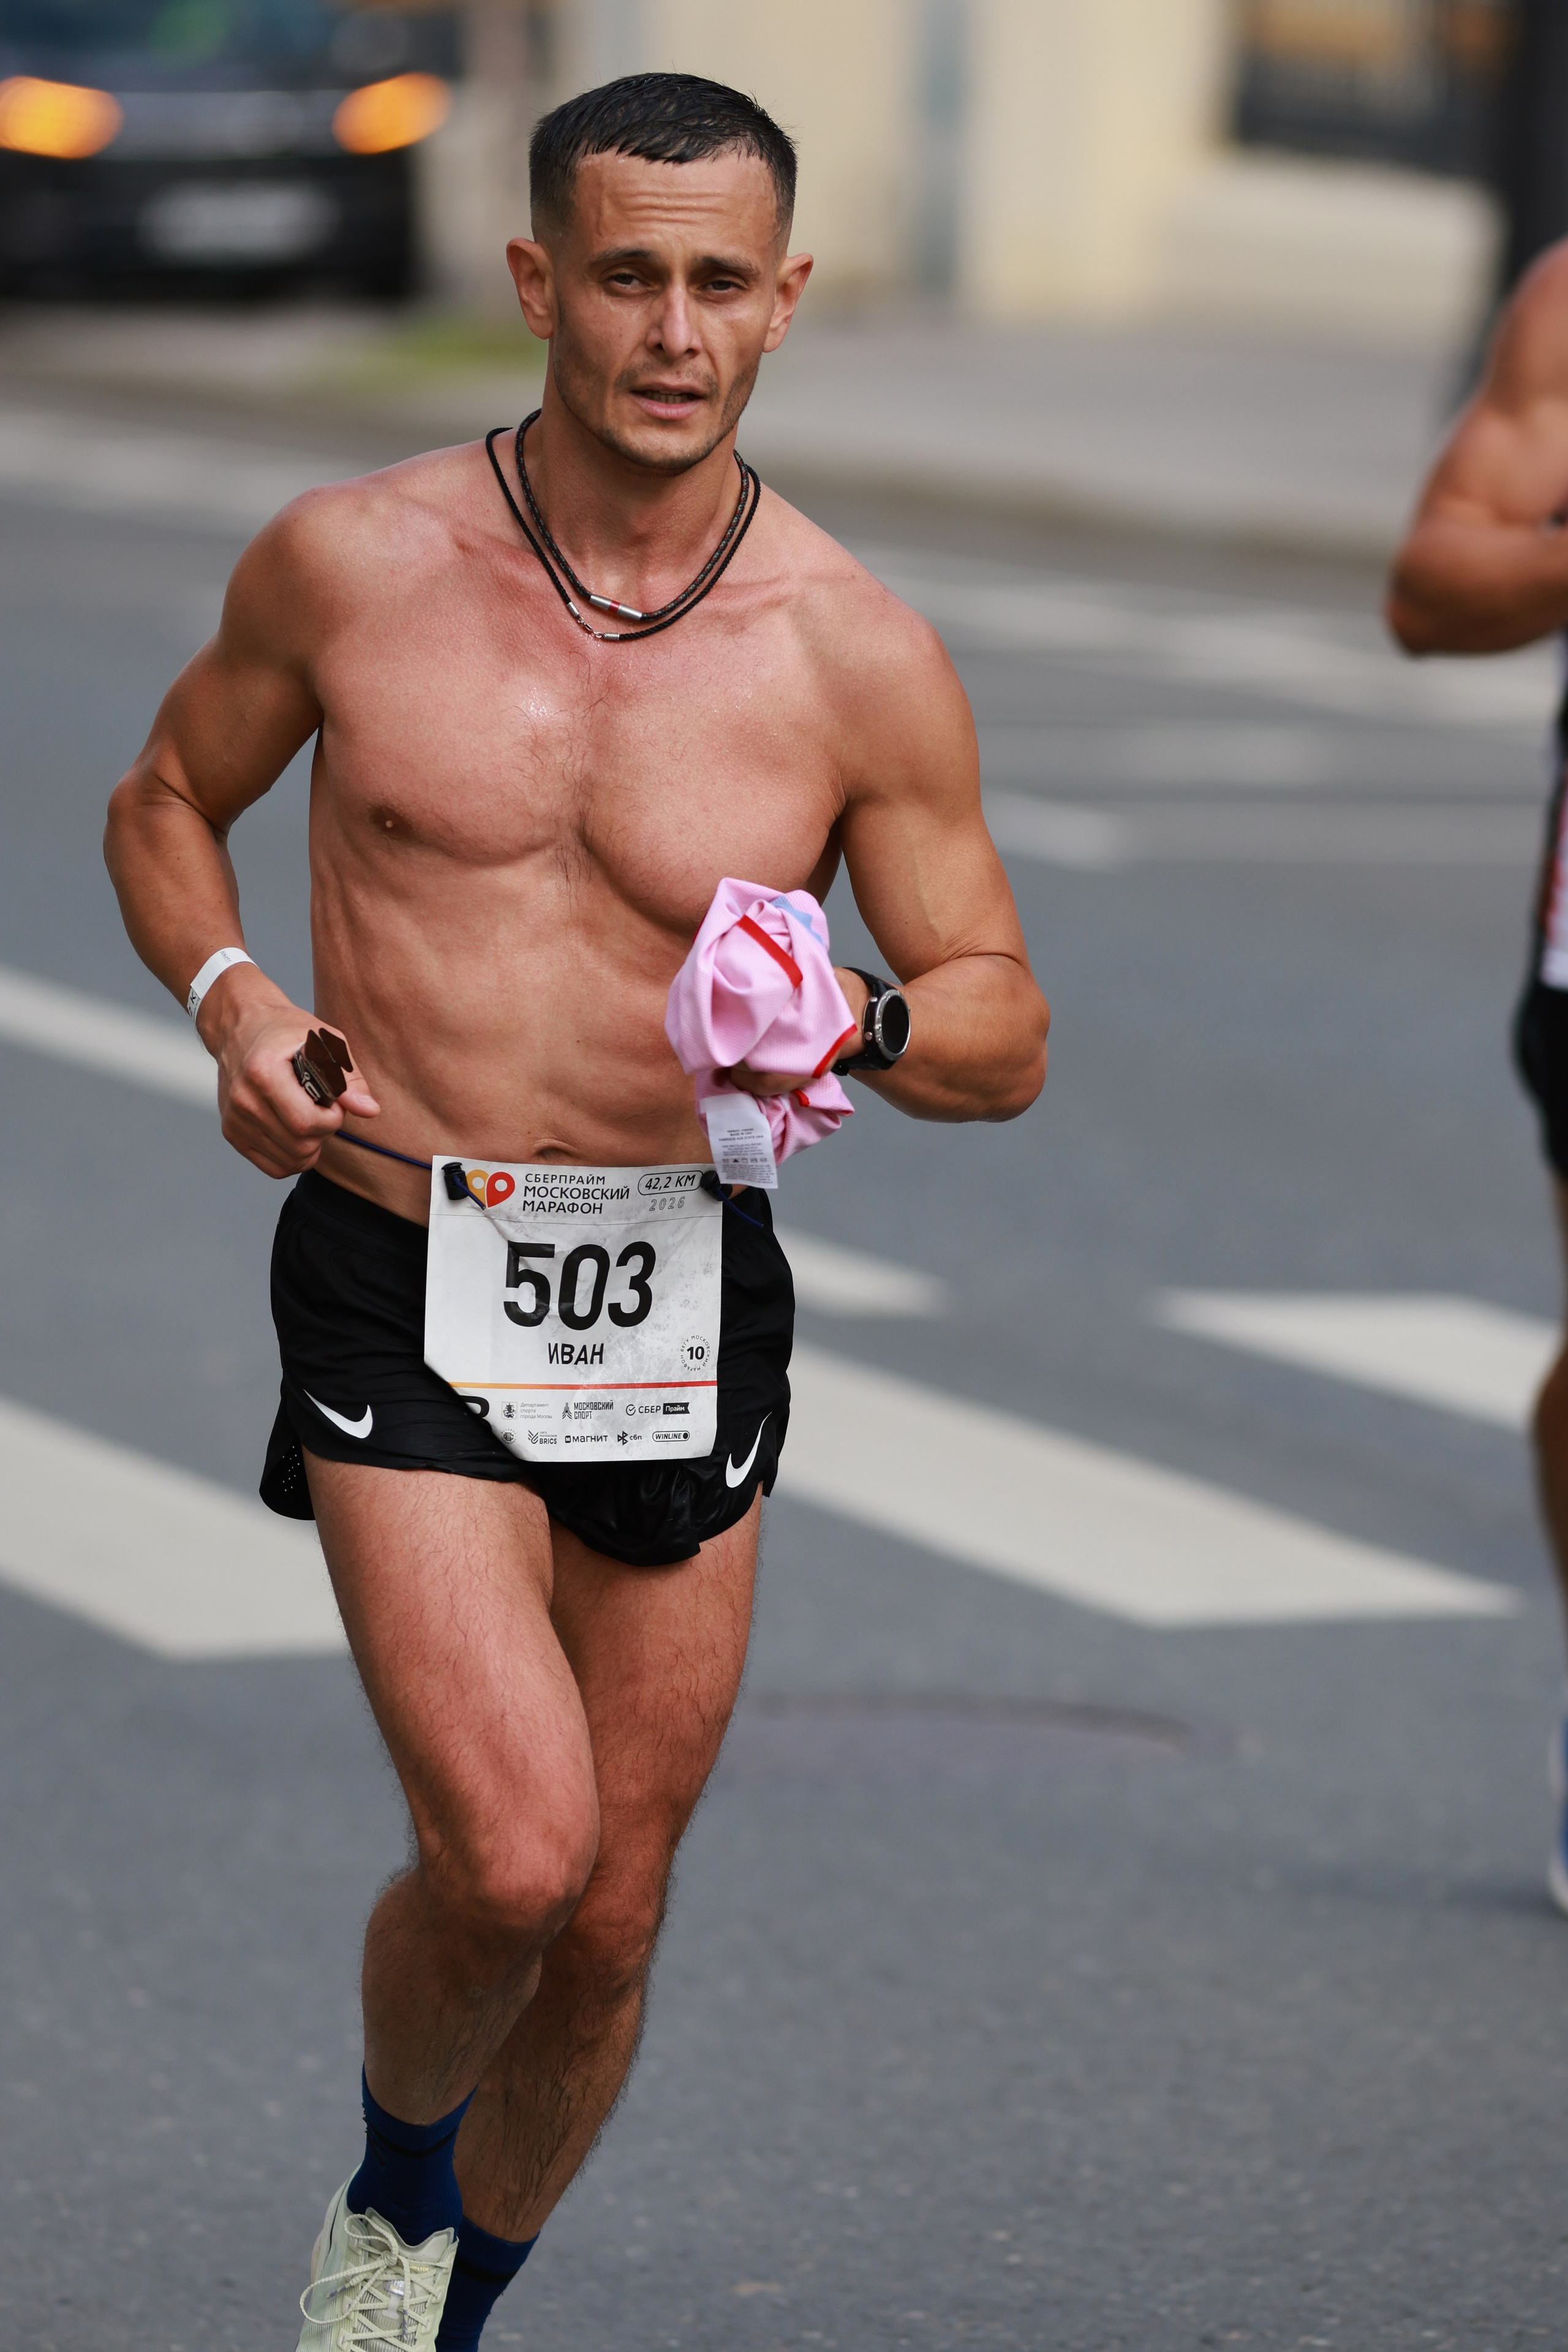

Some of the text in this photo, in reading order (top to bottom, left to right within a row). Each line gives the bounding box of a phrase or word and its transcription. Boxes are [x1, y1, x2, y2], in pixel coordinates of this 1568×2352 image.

[525, 1173, 605, 1185] СБЕРПРАЙМ
[645, 1177, 672, 1190] 42,2
[524, 1186, 630, 1200] МОСКОВСКИЙ
[522, 1200, 603, 1214] МАРАФОН
[649, 1196, 685, 1211] 2026
[503, 1240, 656, 1330] 503
[548, 1343, 604, 1365] ИВАН
[687, 1346, 704, 1360] 10
[691, 1335, 710, 1366] МОСКОВСКИЙ
[680, 1354, 701, 1371] МАРАФОН
[574, 1400, 614, 1411] МОСКОВСКИЙ
[638, 1405, 661, 1414] СБЕР
